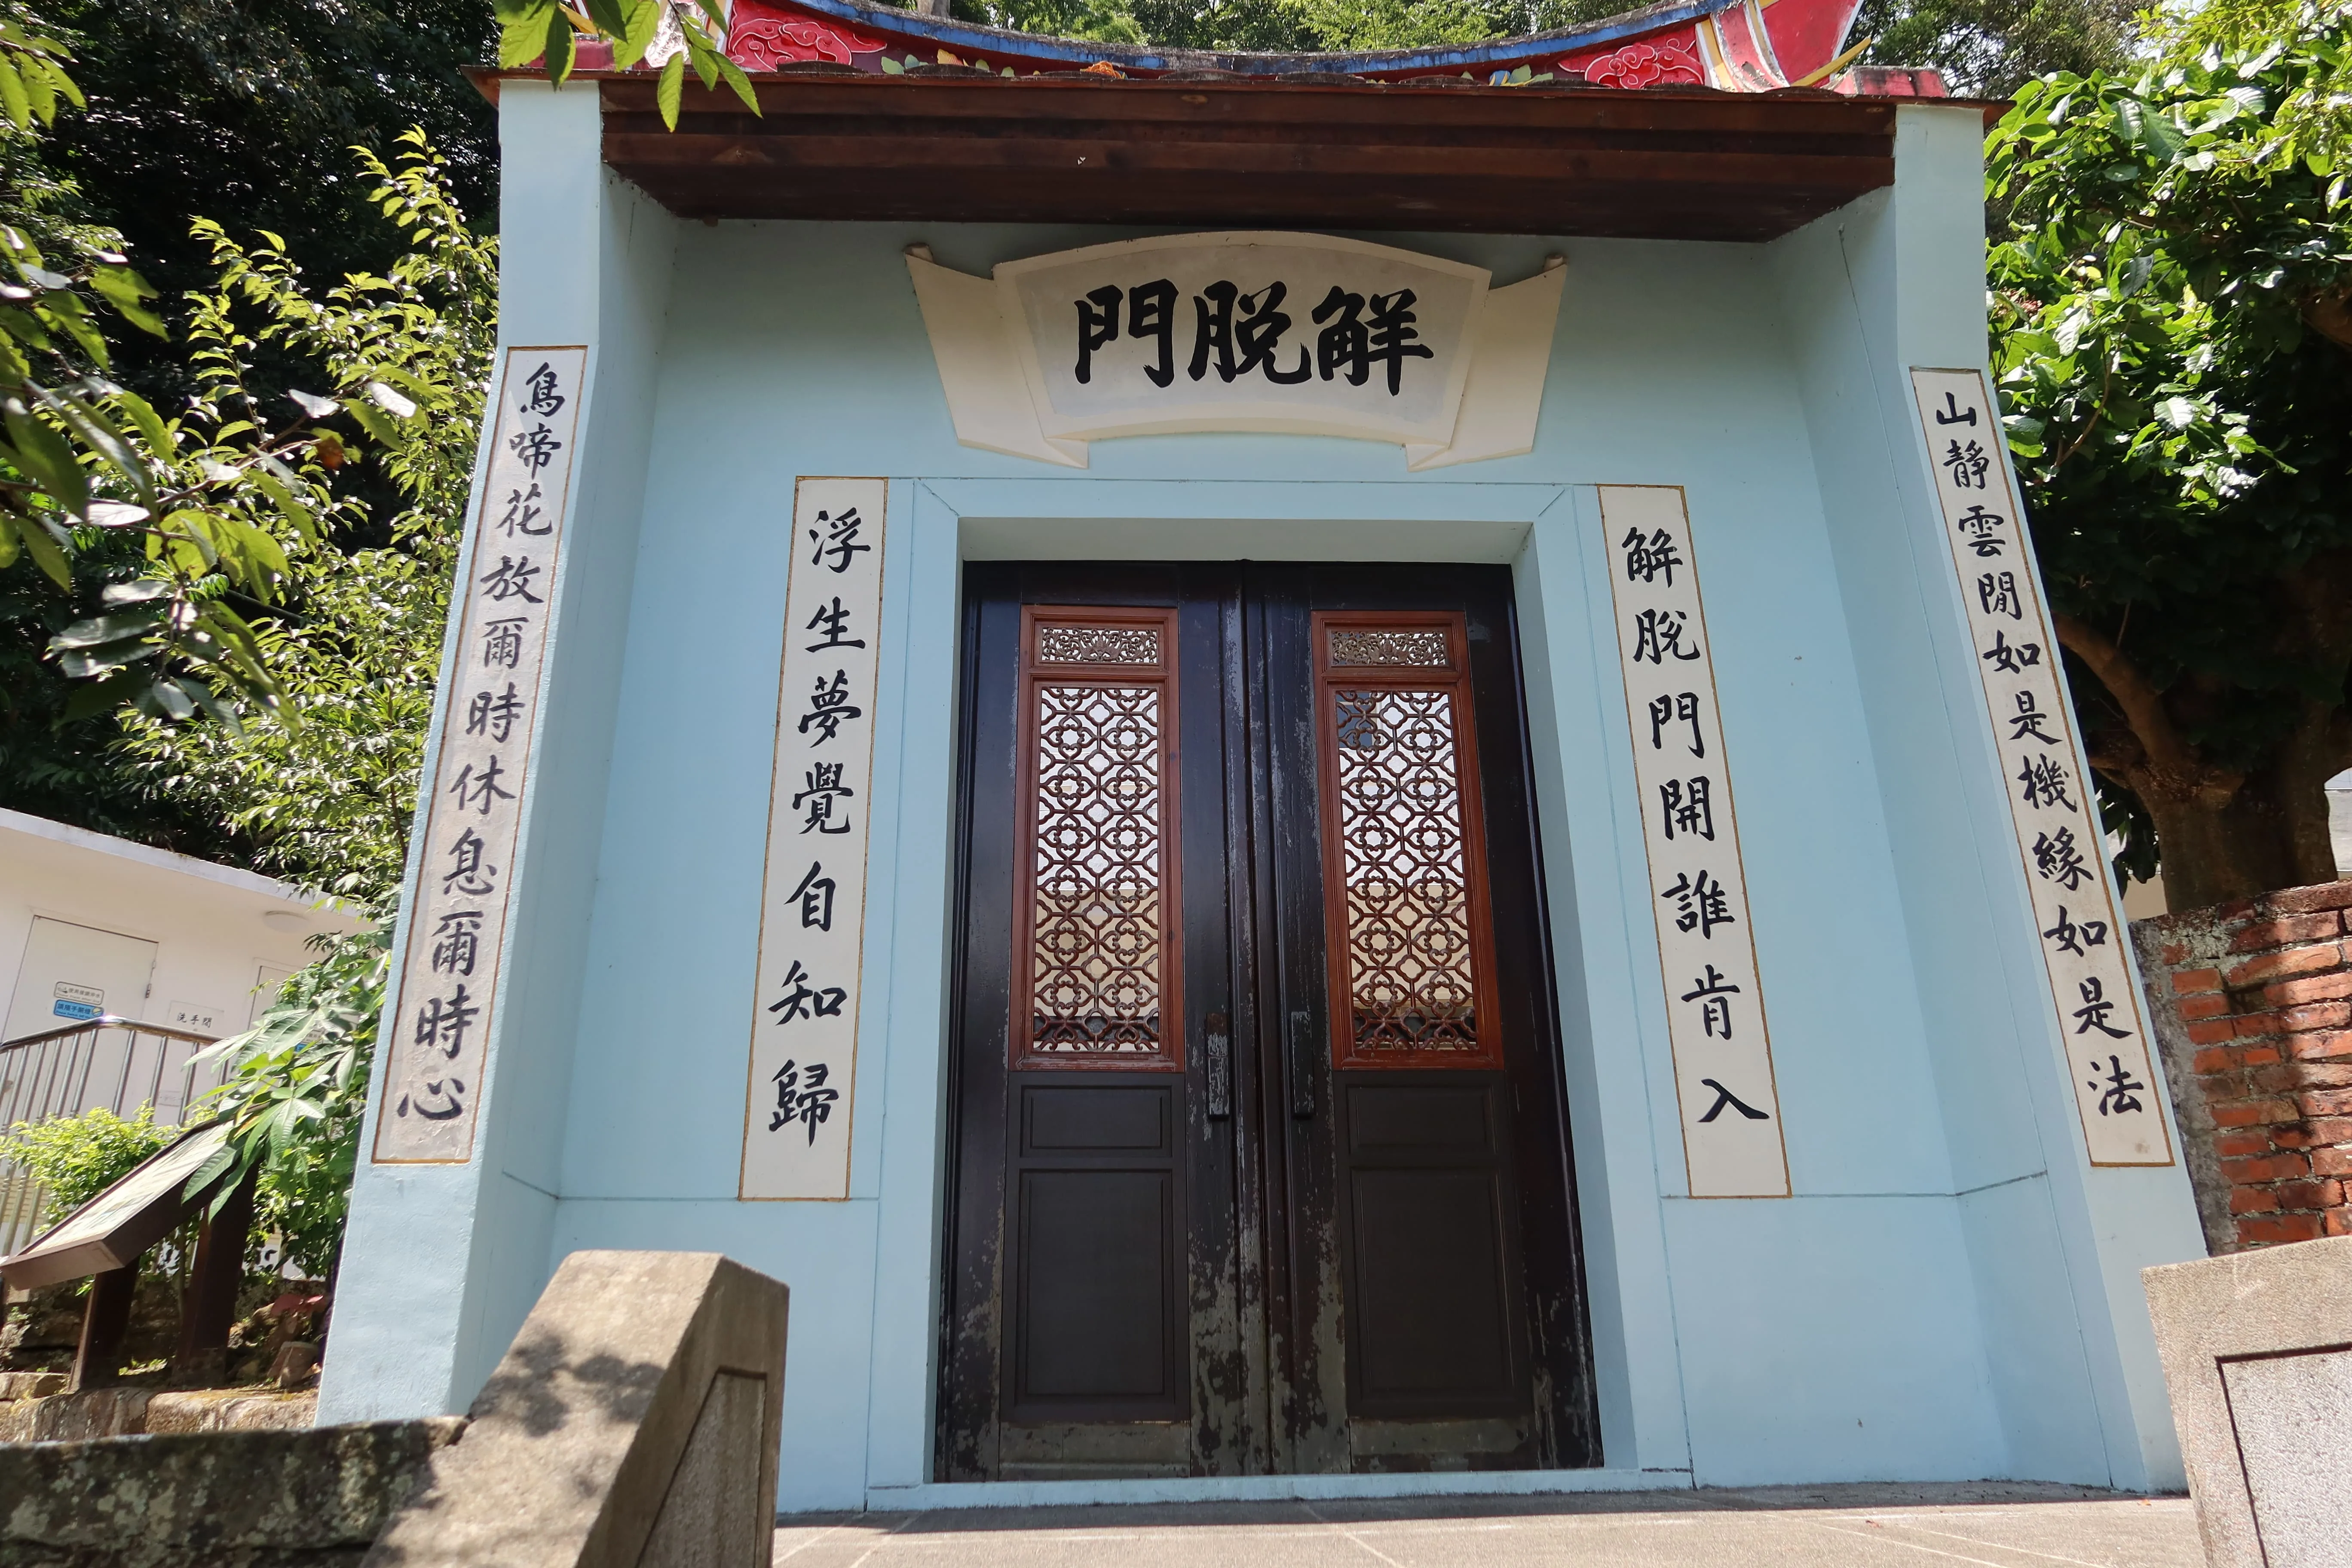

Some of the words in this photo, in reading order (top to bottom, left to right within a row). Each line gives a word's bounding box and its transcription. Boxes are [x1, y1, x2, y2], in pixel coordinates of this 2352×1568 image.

[768, 507, 871, 1147] 浮生夢覺自知歸
[177, 1012, 212, 1028] 洗手間
